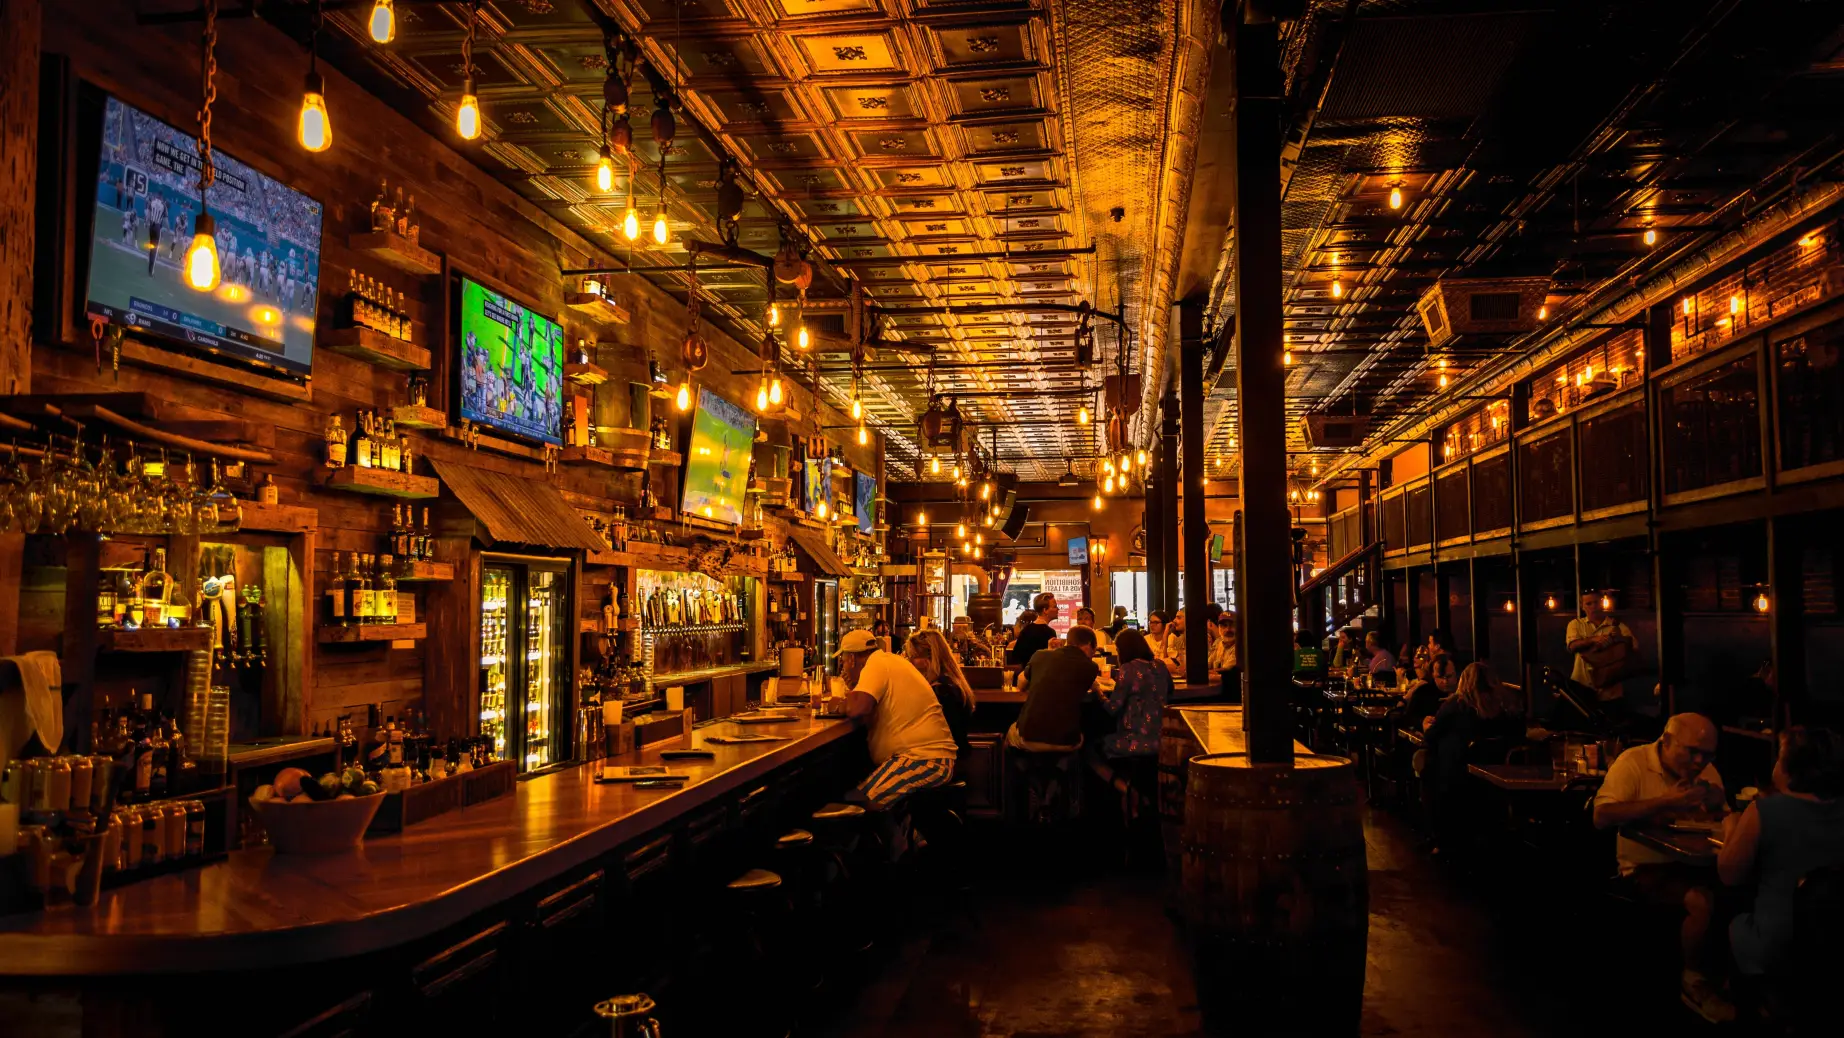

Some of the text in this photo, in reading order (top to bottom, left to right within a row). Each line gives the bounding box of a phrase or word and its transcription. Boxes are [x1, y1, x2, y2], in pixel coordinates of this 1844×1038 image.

[156, 140, 170, 154] NOW
[170, 147, 179, 159] WE
[180, 151, 190, 164] GET
[223, 172, 245, 190] POSITION
[173, 160, 184, 174] THE
